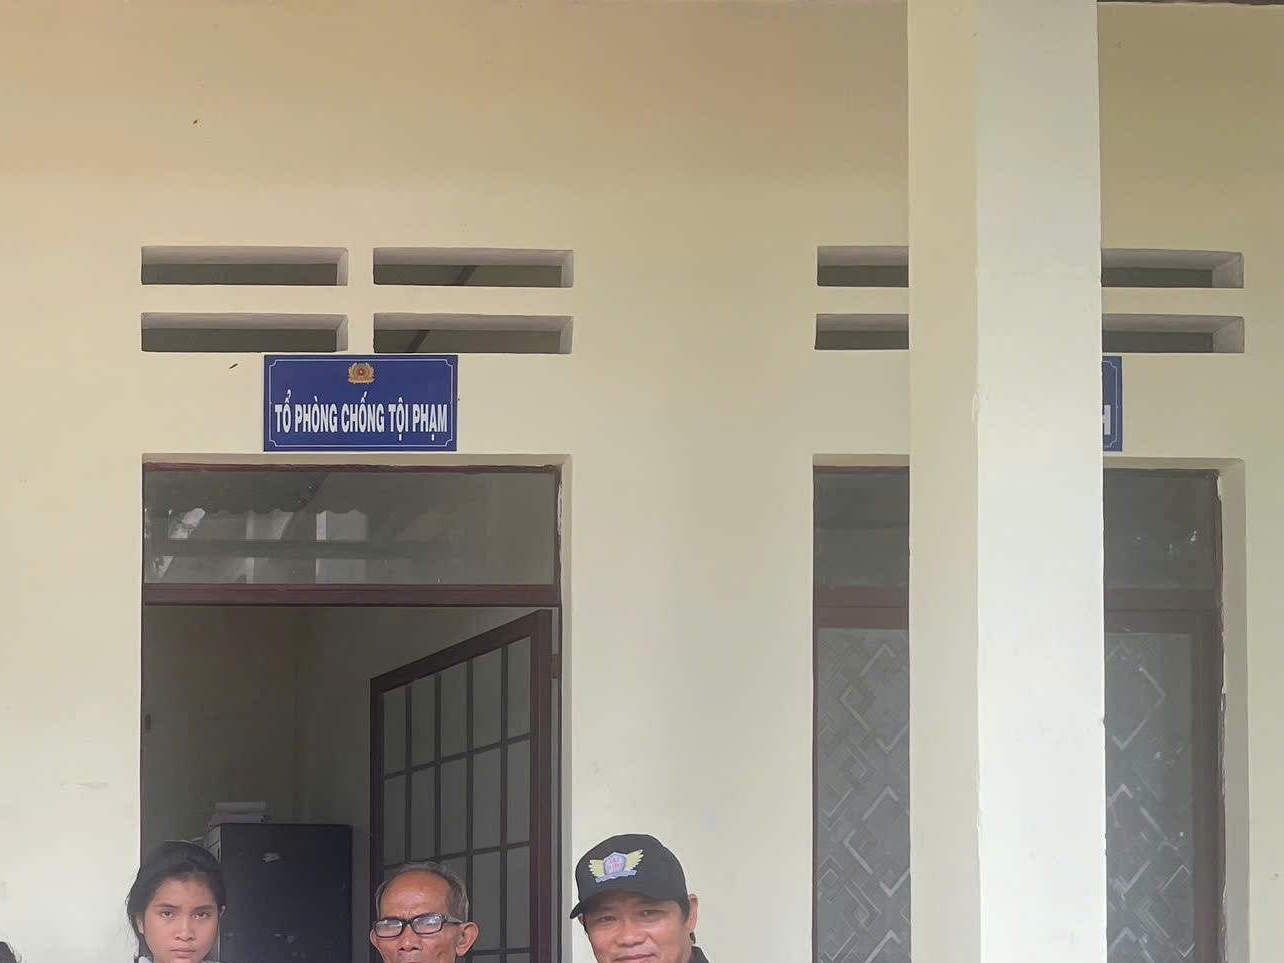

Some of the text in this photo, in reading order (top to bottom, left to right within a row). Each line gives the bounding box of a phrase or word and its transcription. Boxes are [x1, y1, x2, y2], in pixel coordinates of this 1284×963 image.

[274, 389, 448, 441] TỔ PHÒNG CHỐNG TỘI PHẠM
